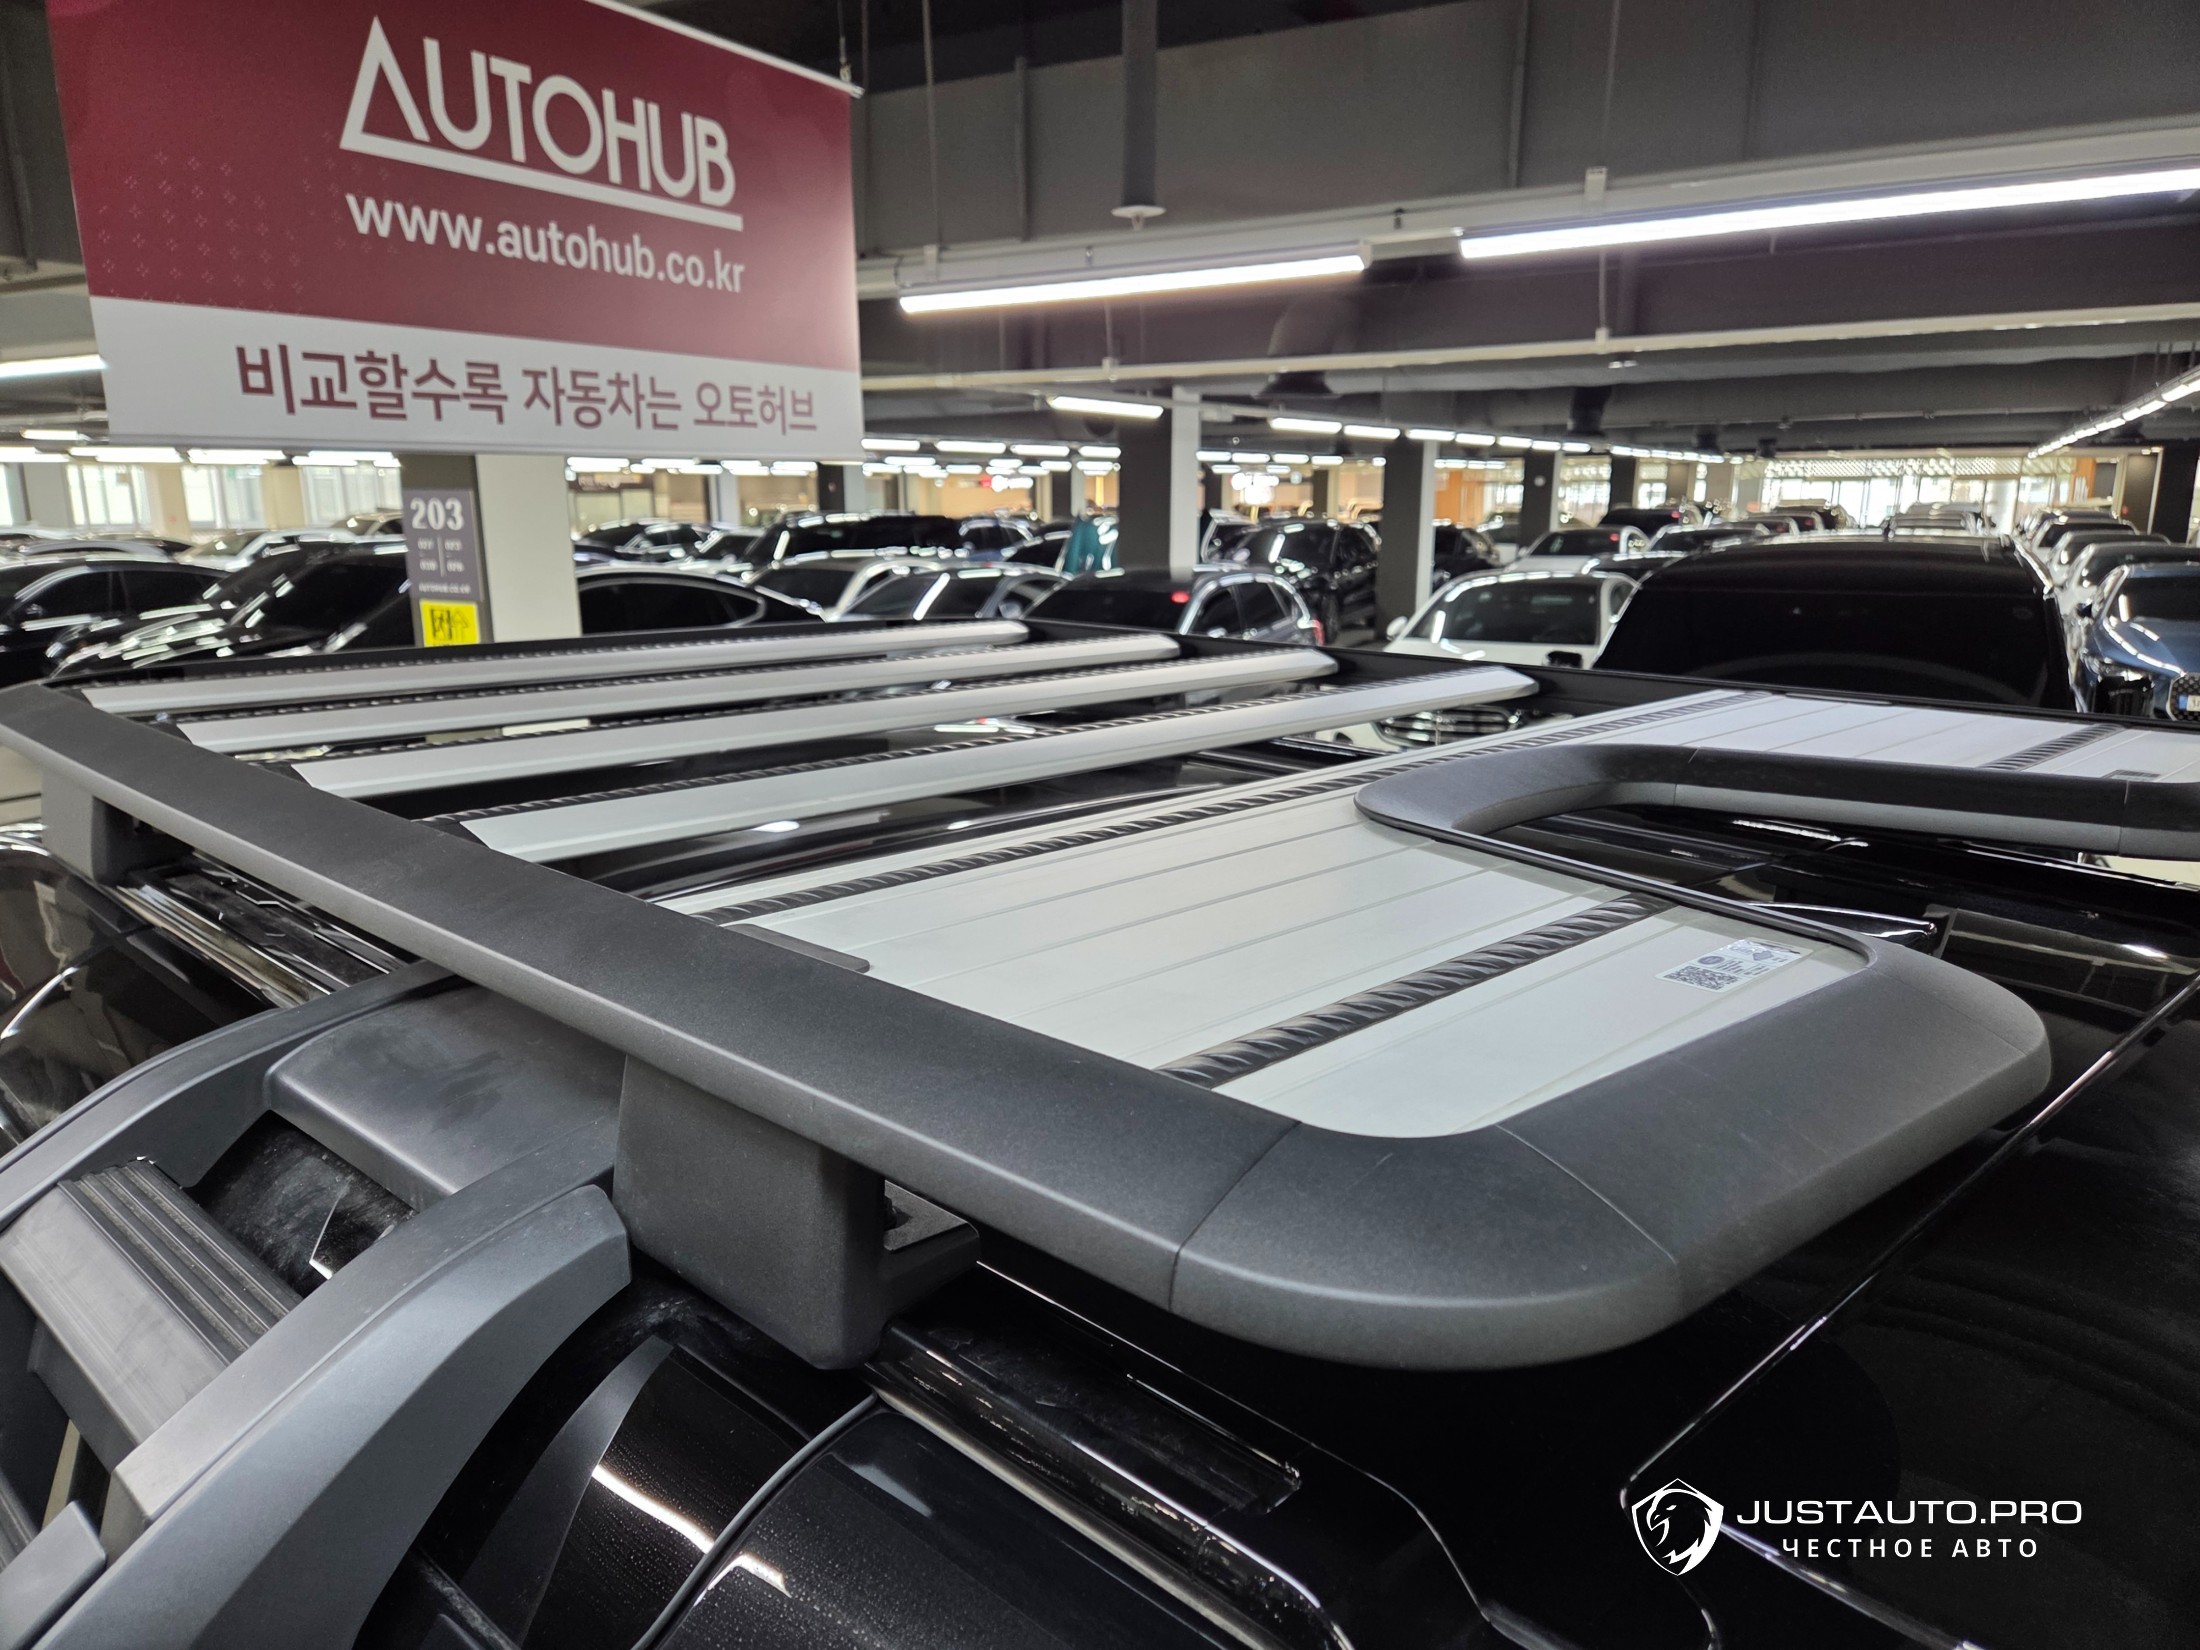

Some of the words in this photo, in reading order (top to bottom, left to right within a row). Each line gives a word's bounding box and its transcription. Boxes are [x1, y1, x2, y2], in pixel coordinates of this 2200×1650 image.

[340, 16, 737, 206] AUTOHUB
[346, 193, 745, 293] www.autohub.co.kr
[235, 343, 509, 423] 비교할수록
[522, 363, 682, 430] 자동차는
[693, 384, 818, 436] 오토허브
[410, 497, 464, 531] 203
